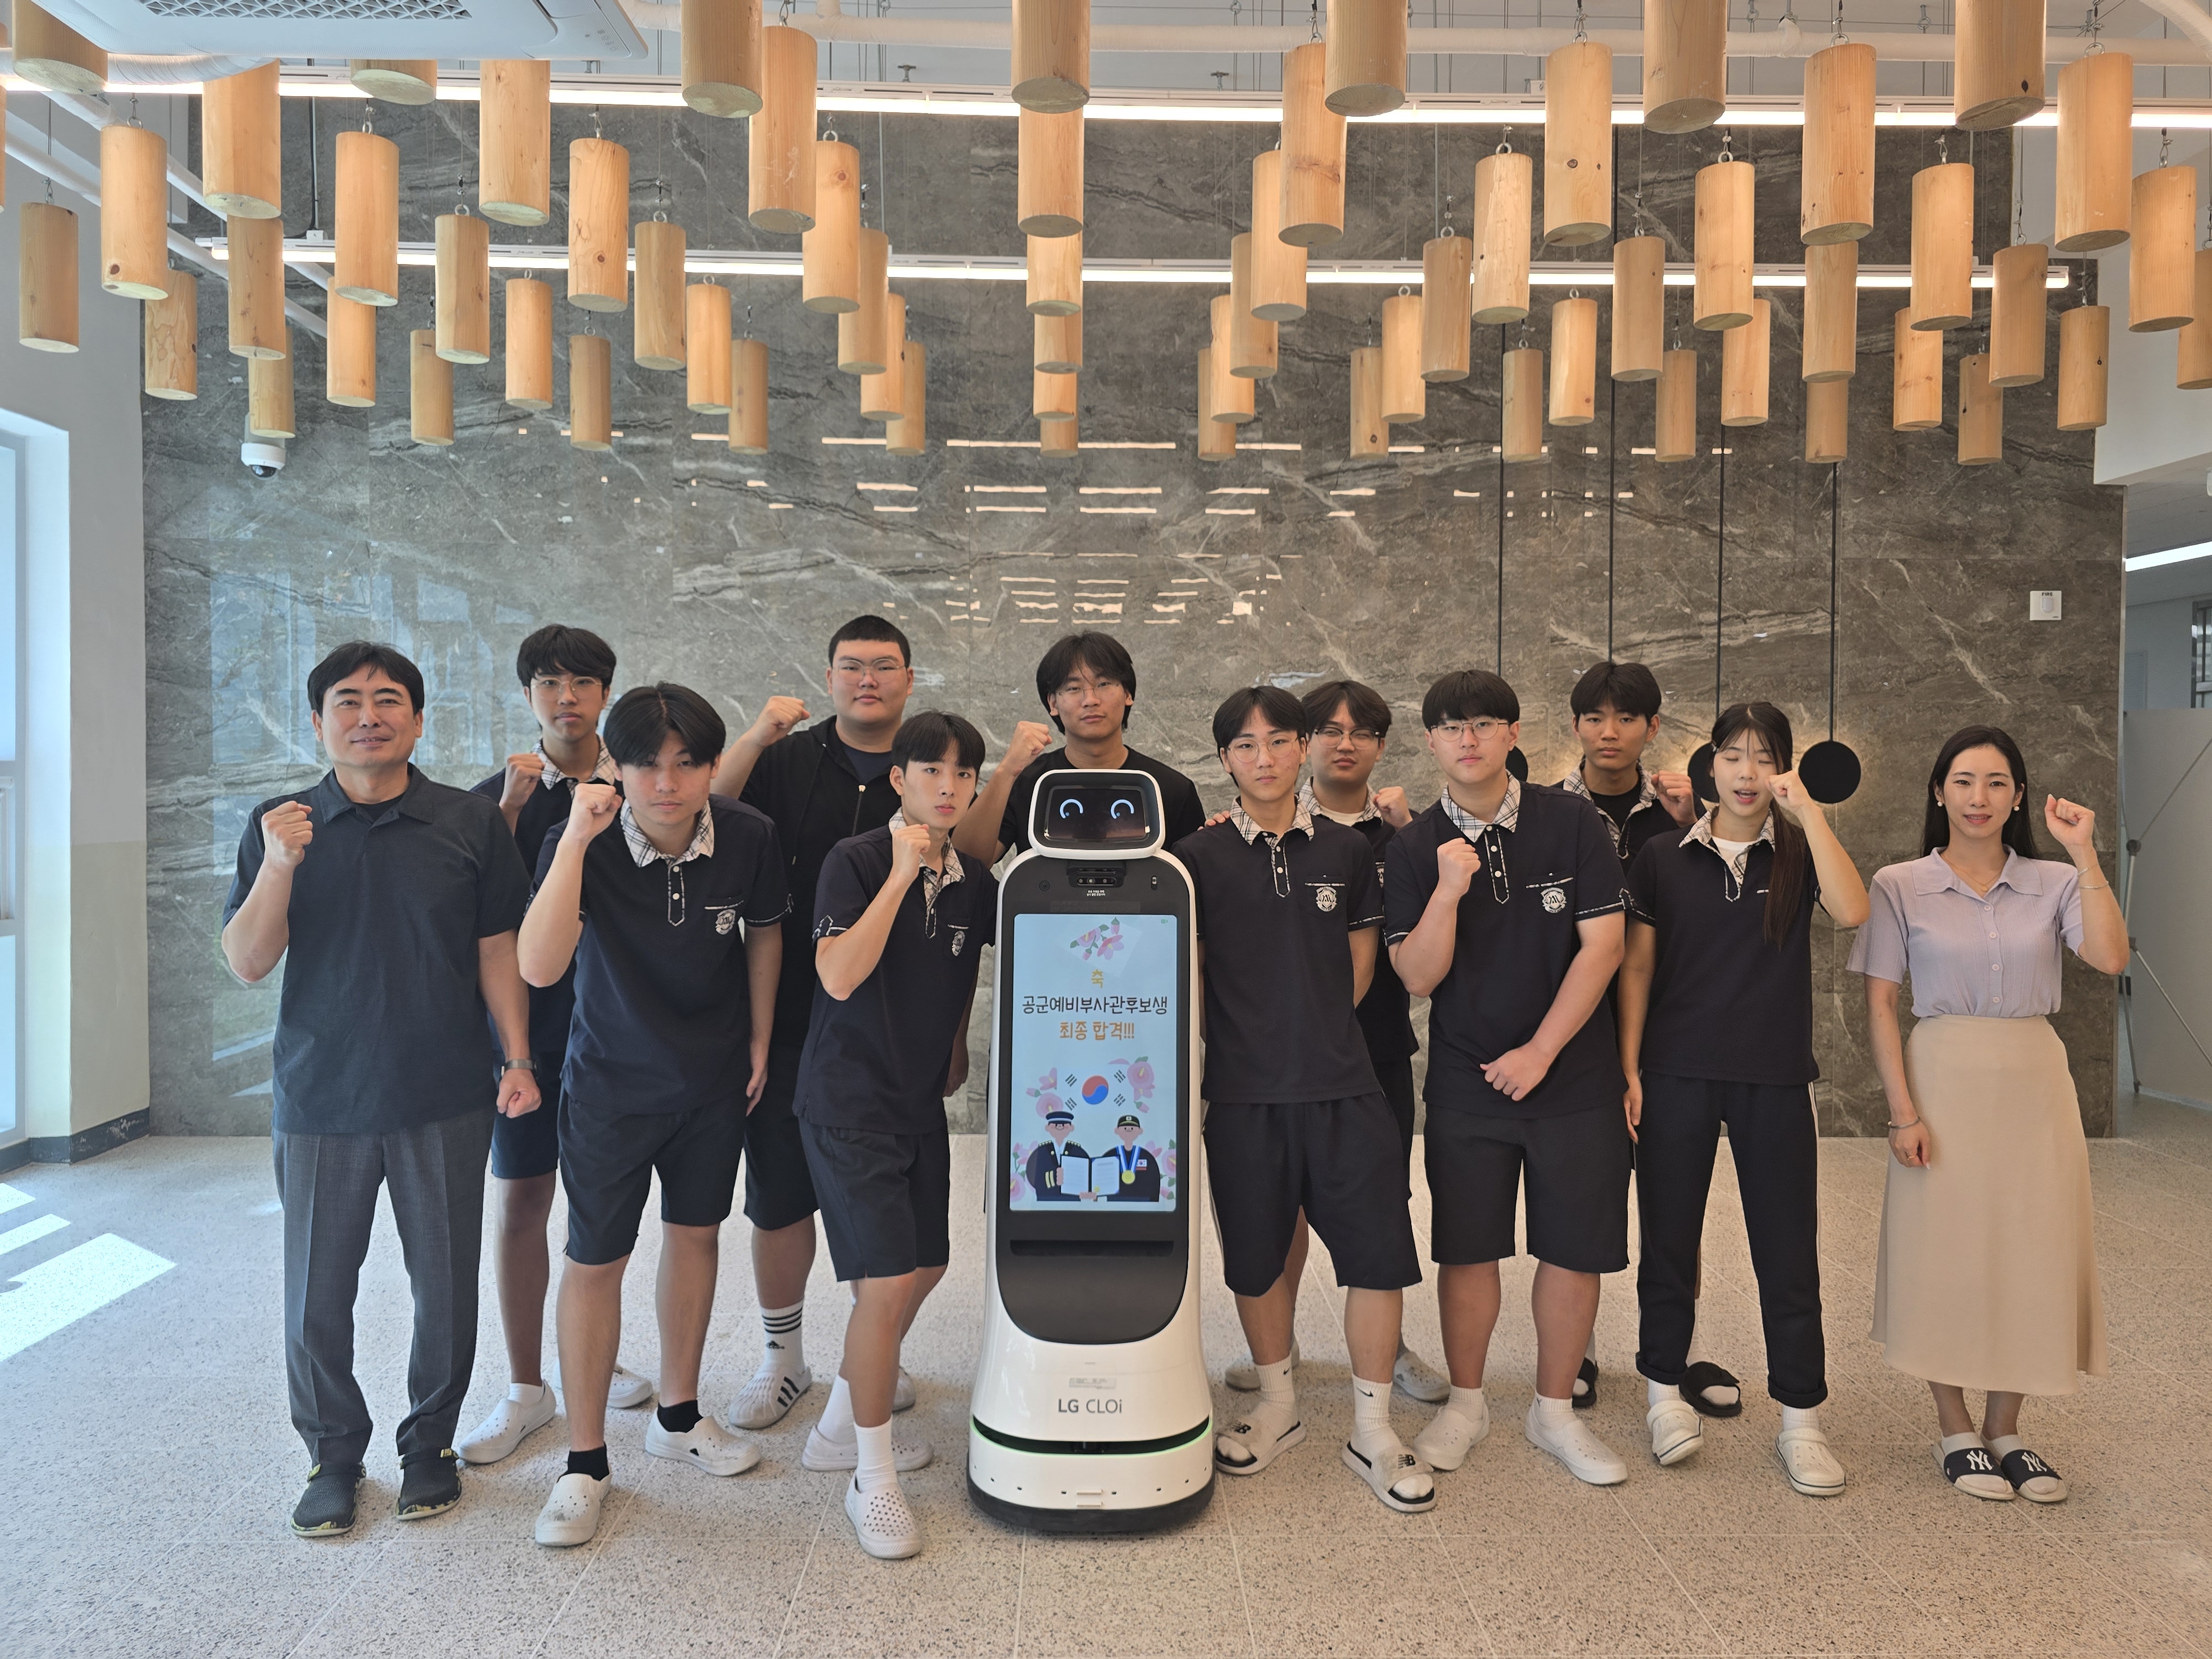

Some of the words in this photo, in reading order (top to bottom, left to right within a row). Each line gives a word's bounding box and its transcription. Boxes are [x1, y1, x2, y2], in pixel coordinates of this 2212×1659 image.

[1091, 969, 1104, 989] 축
[1022, 995, 1167, 1015] 공군예비부사관후보생
[1059, 1021, 1088, 1041] 최종
[1092, 1021, 1135, 1041] 합격!!!
[1058, 1399, 1079, 1413] LG
[1086, 1399, 1122, 1413] CLOi
